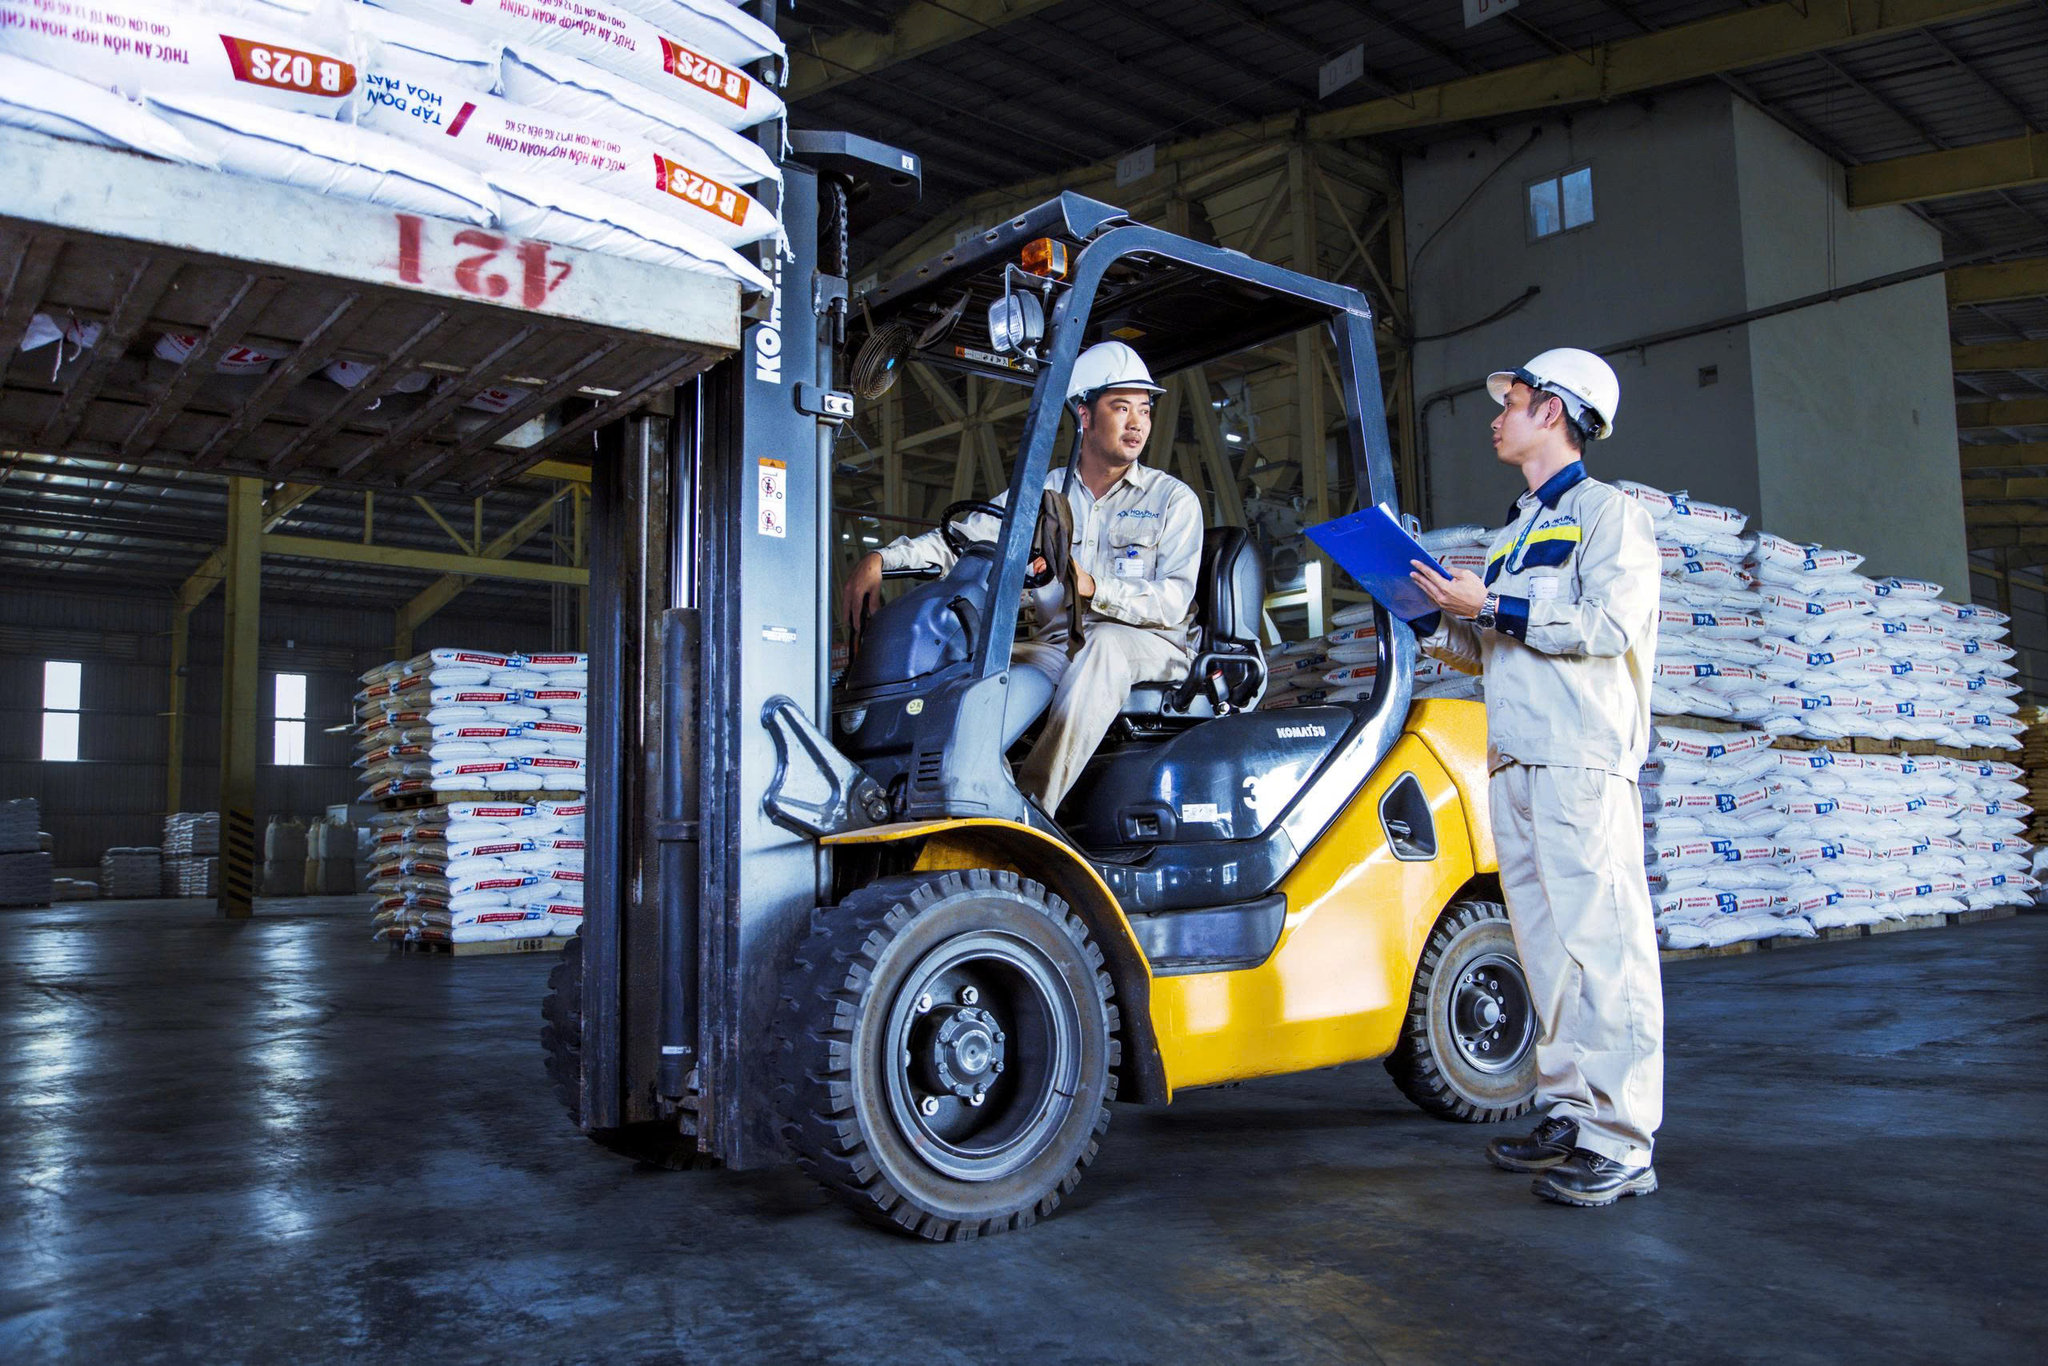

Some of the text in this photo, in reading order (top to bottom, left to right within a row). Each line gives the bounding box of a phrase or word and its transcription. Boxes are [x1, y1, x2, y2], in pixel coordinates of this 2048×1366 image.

[251, 48, 341, 92] B 02S
[678, 53, 743, 98] B 02S
[506, 120, 515, 131] KG
[517, 123, 526, 134] 25
[670, 169, 737, 218] B 02S
[1276, 724, 1326, 739] KOMATSU
